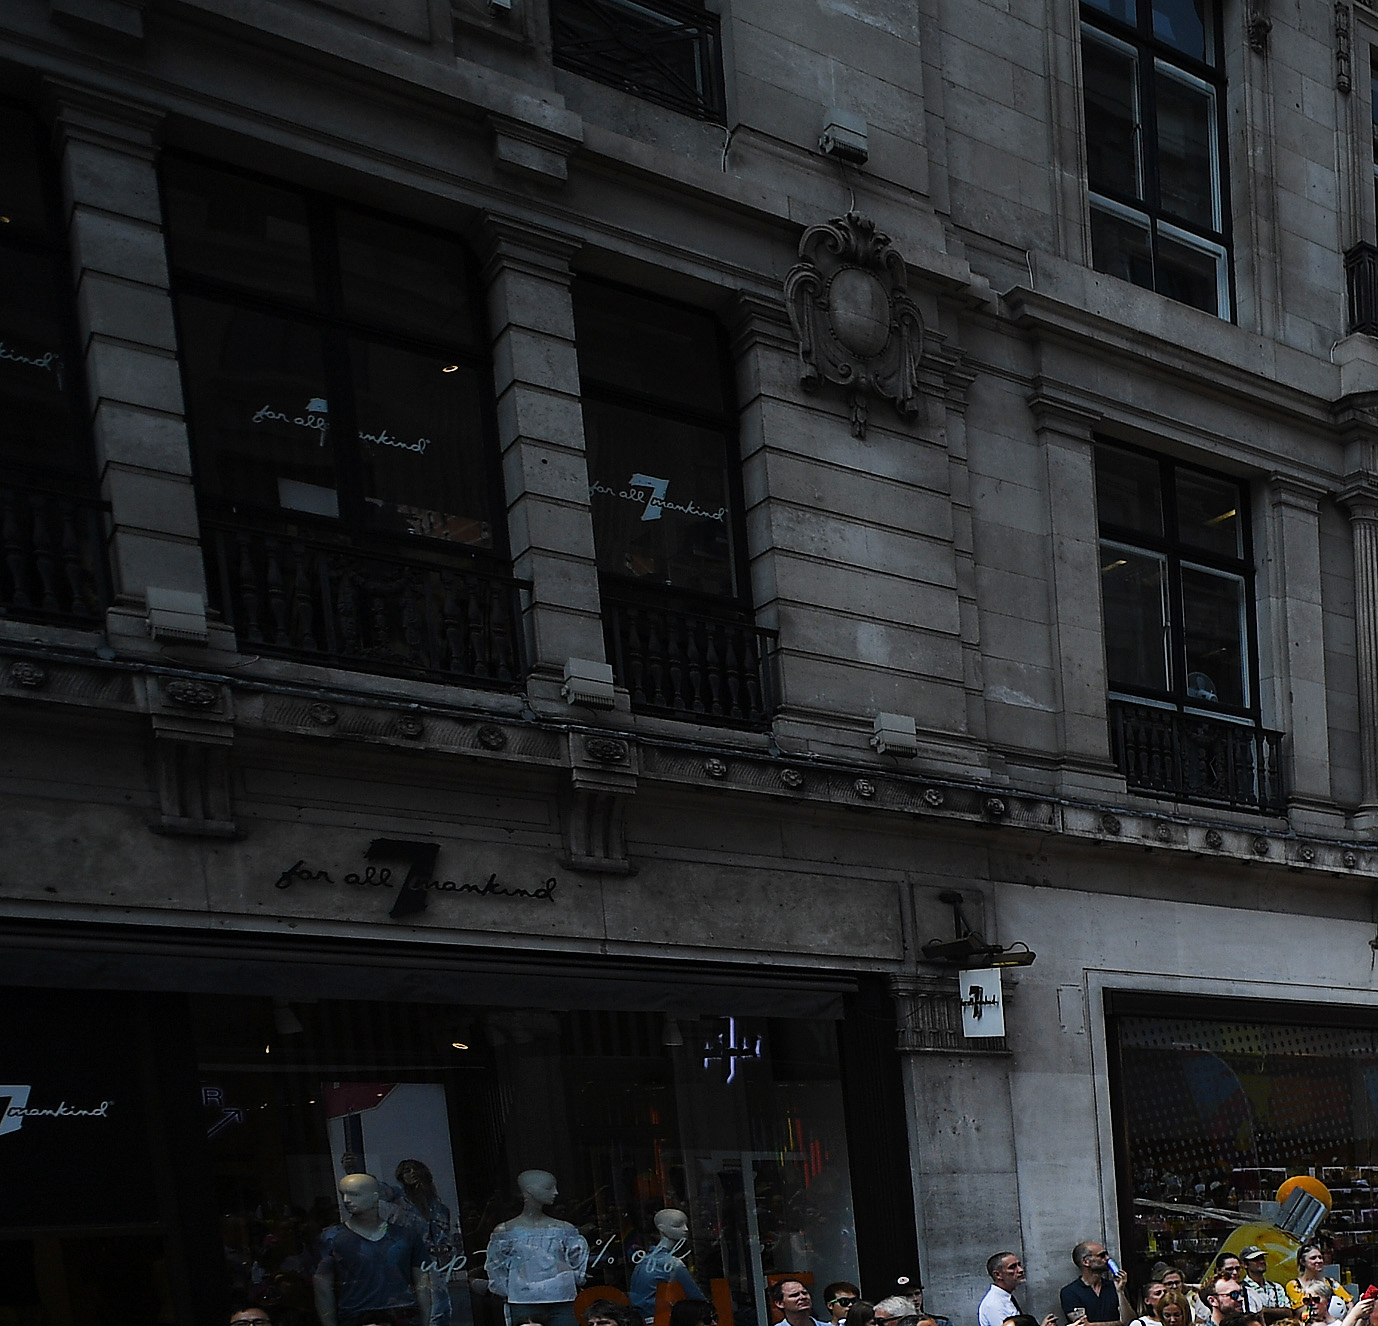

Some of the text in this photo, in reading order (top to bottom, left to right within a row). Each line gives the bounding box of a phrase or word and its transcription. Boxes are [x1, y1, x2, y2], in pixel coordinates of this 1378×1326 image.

[0, 341, 53, 371] kind
[294, 411, 327, 432] all
[619, 487, 646, 504] all
[629, 472, 670, 522] 7
[651, 497, 727, 522] mankind
[275, 837, 557, 918] for all 7 mankind
[9, 1100, 108, 1117] mankind
[421, 1254, 467, 1283] up
